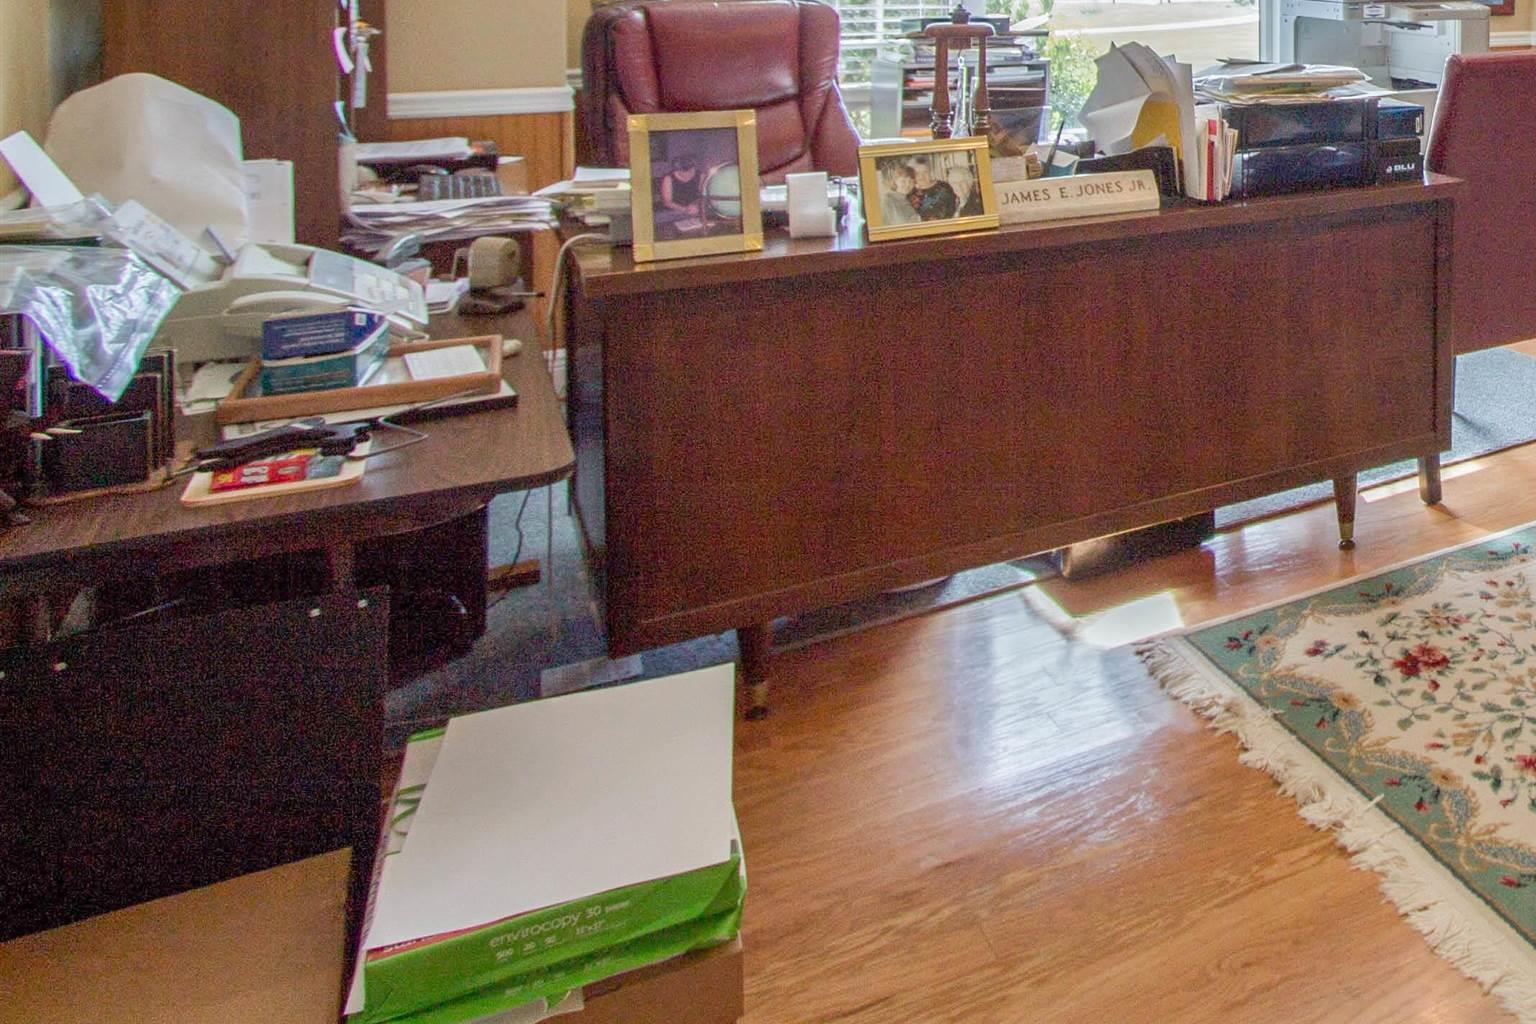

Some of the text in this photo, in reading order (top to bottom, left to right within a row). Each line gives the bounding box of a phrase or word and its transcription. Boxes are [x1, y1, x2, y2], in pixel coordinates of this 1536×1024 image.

[1001, 178, 1150, 205] JAMES E. JONES JR.
[489, 910, 581, 949] envirocopy
